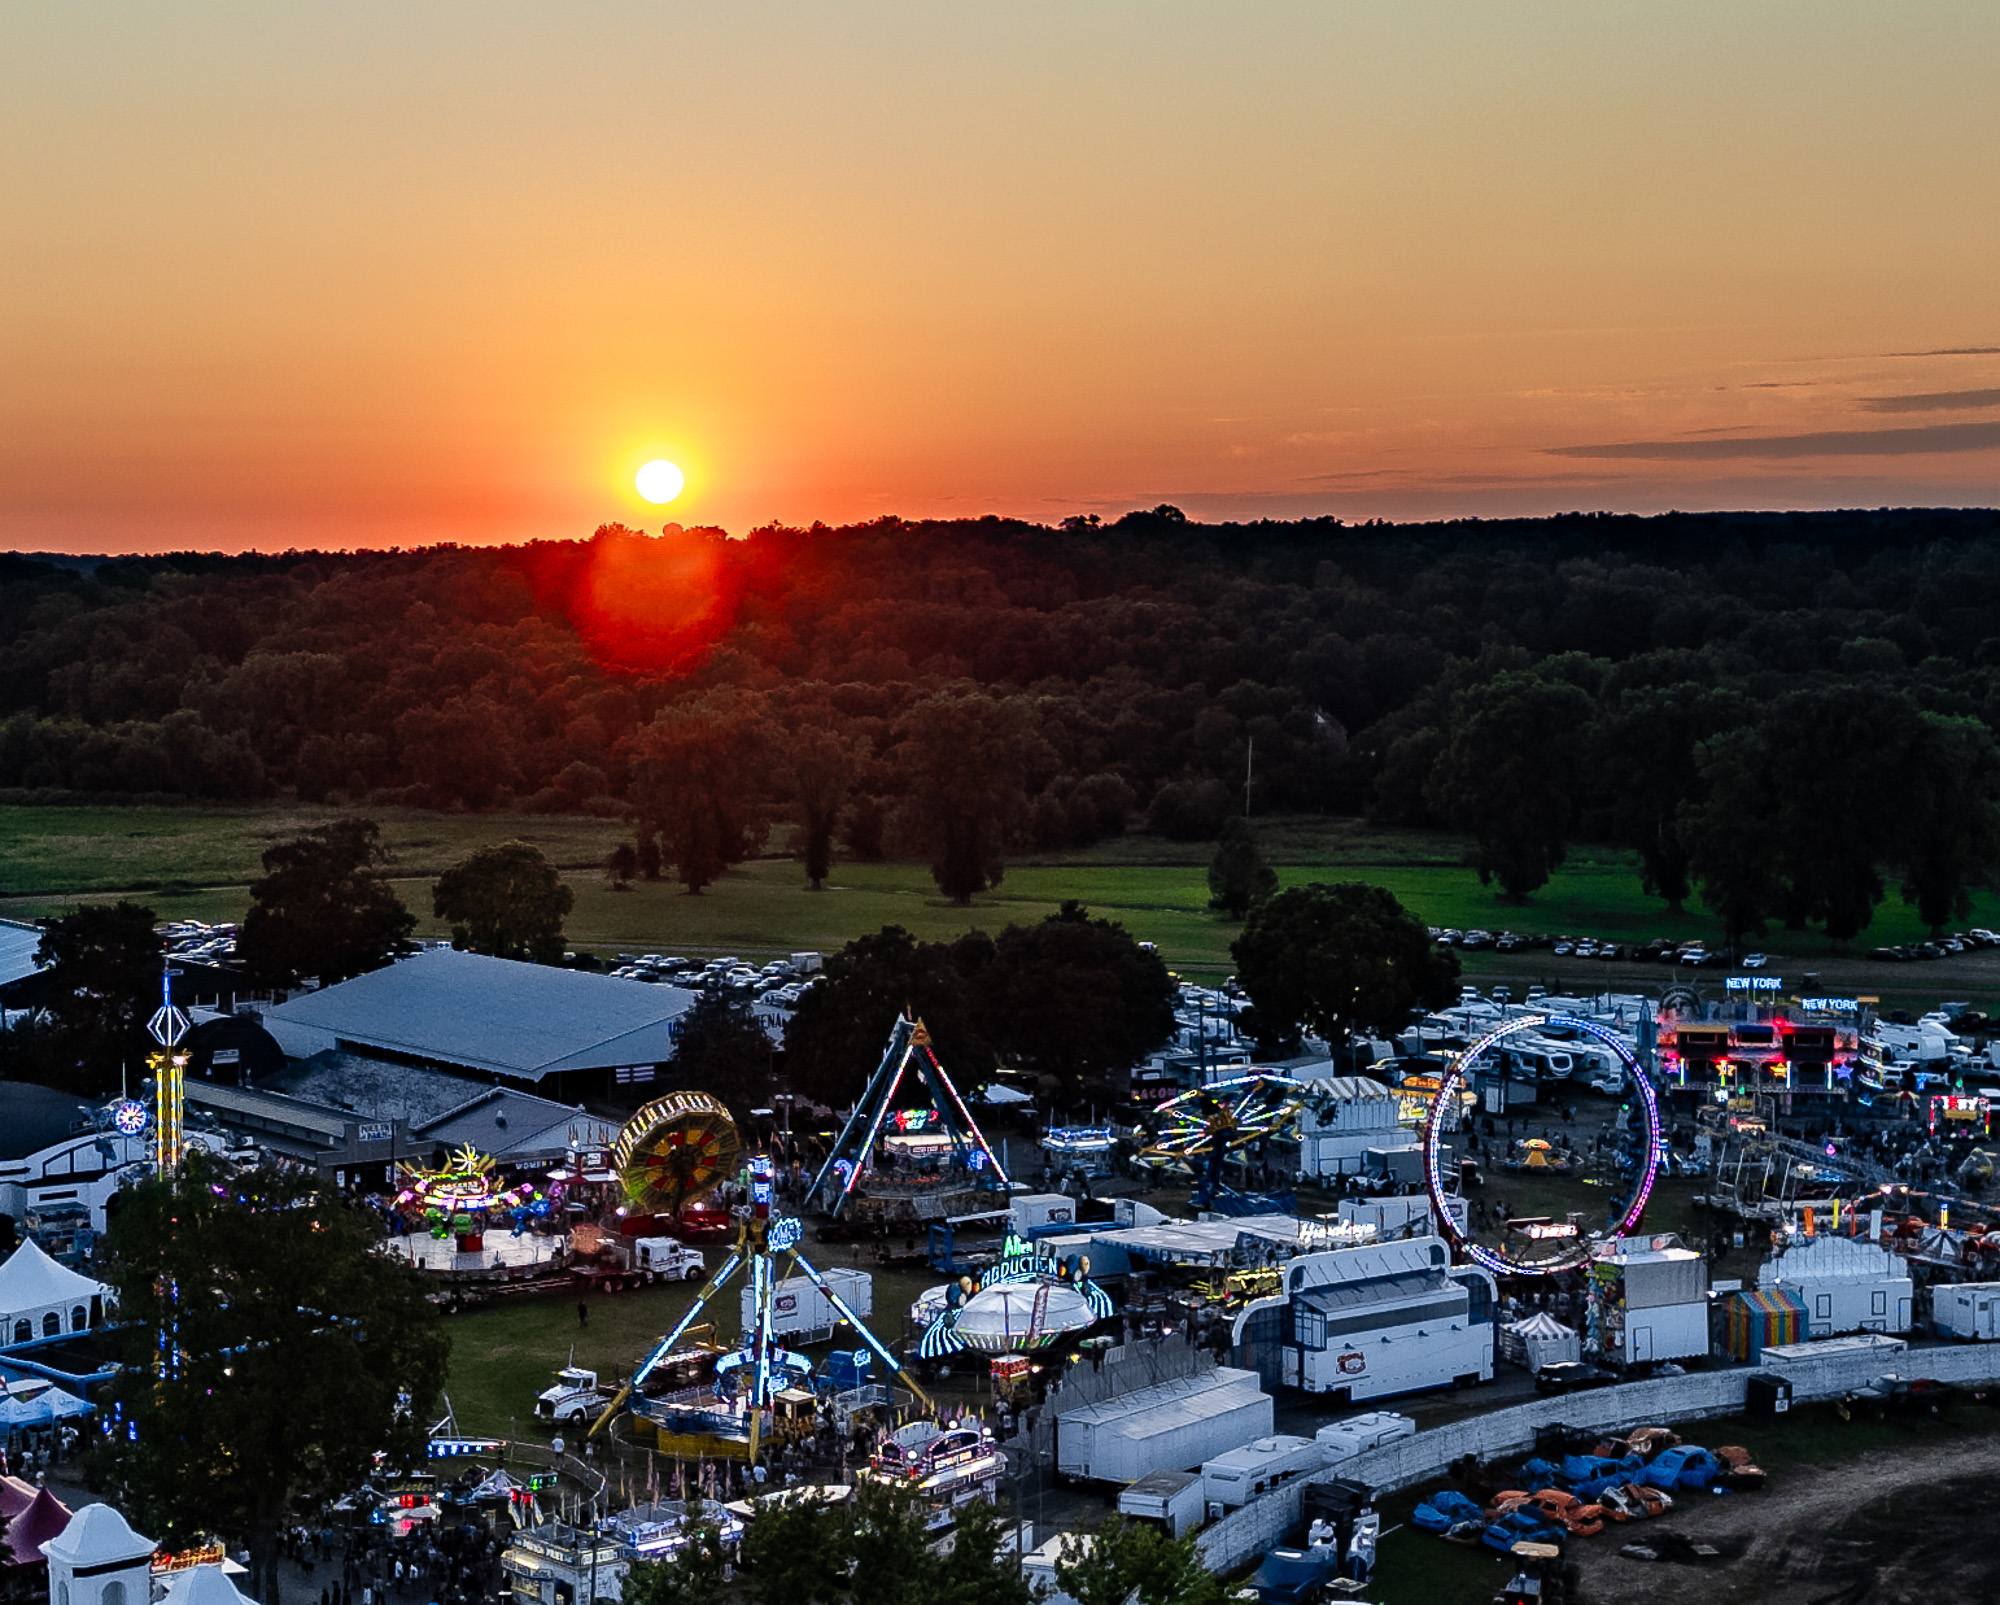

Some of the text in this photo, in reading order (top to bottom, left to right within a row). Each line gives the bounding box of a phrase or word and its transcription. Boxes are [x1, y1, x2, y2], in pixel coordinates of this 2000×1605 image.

[1726, 977, 1782, 989] NEW YORK
[1802, 998, 1858, 1011] NEW YORK
